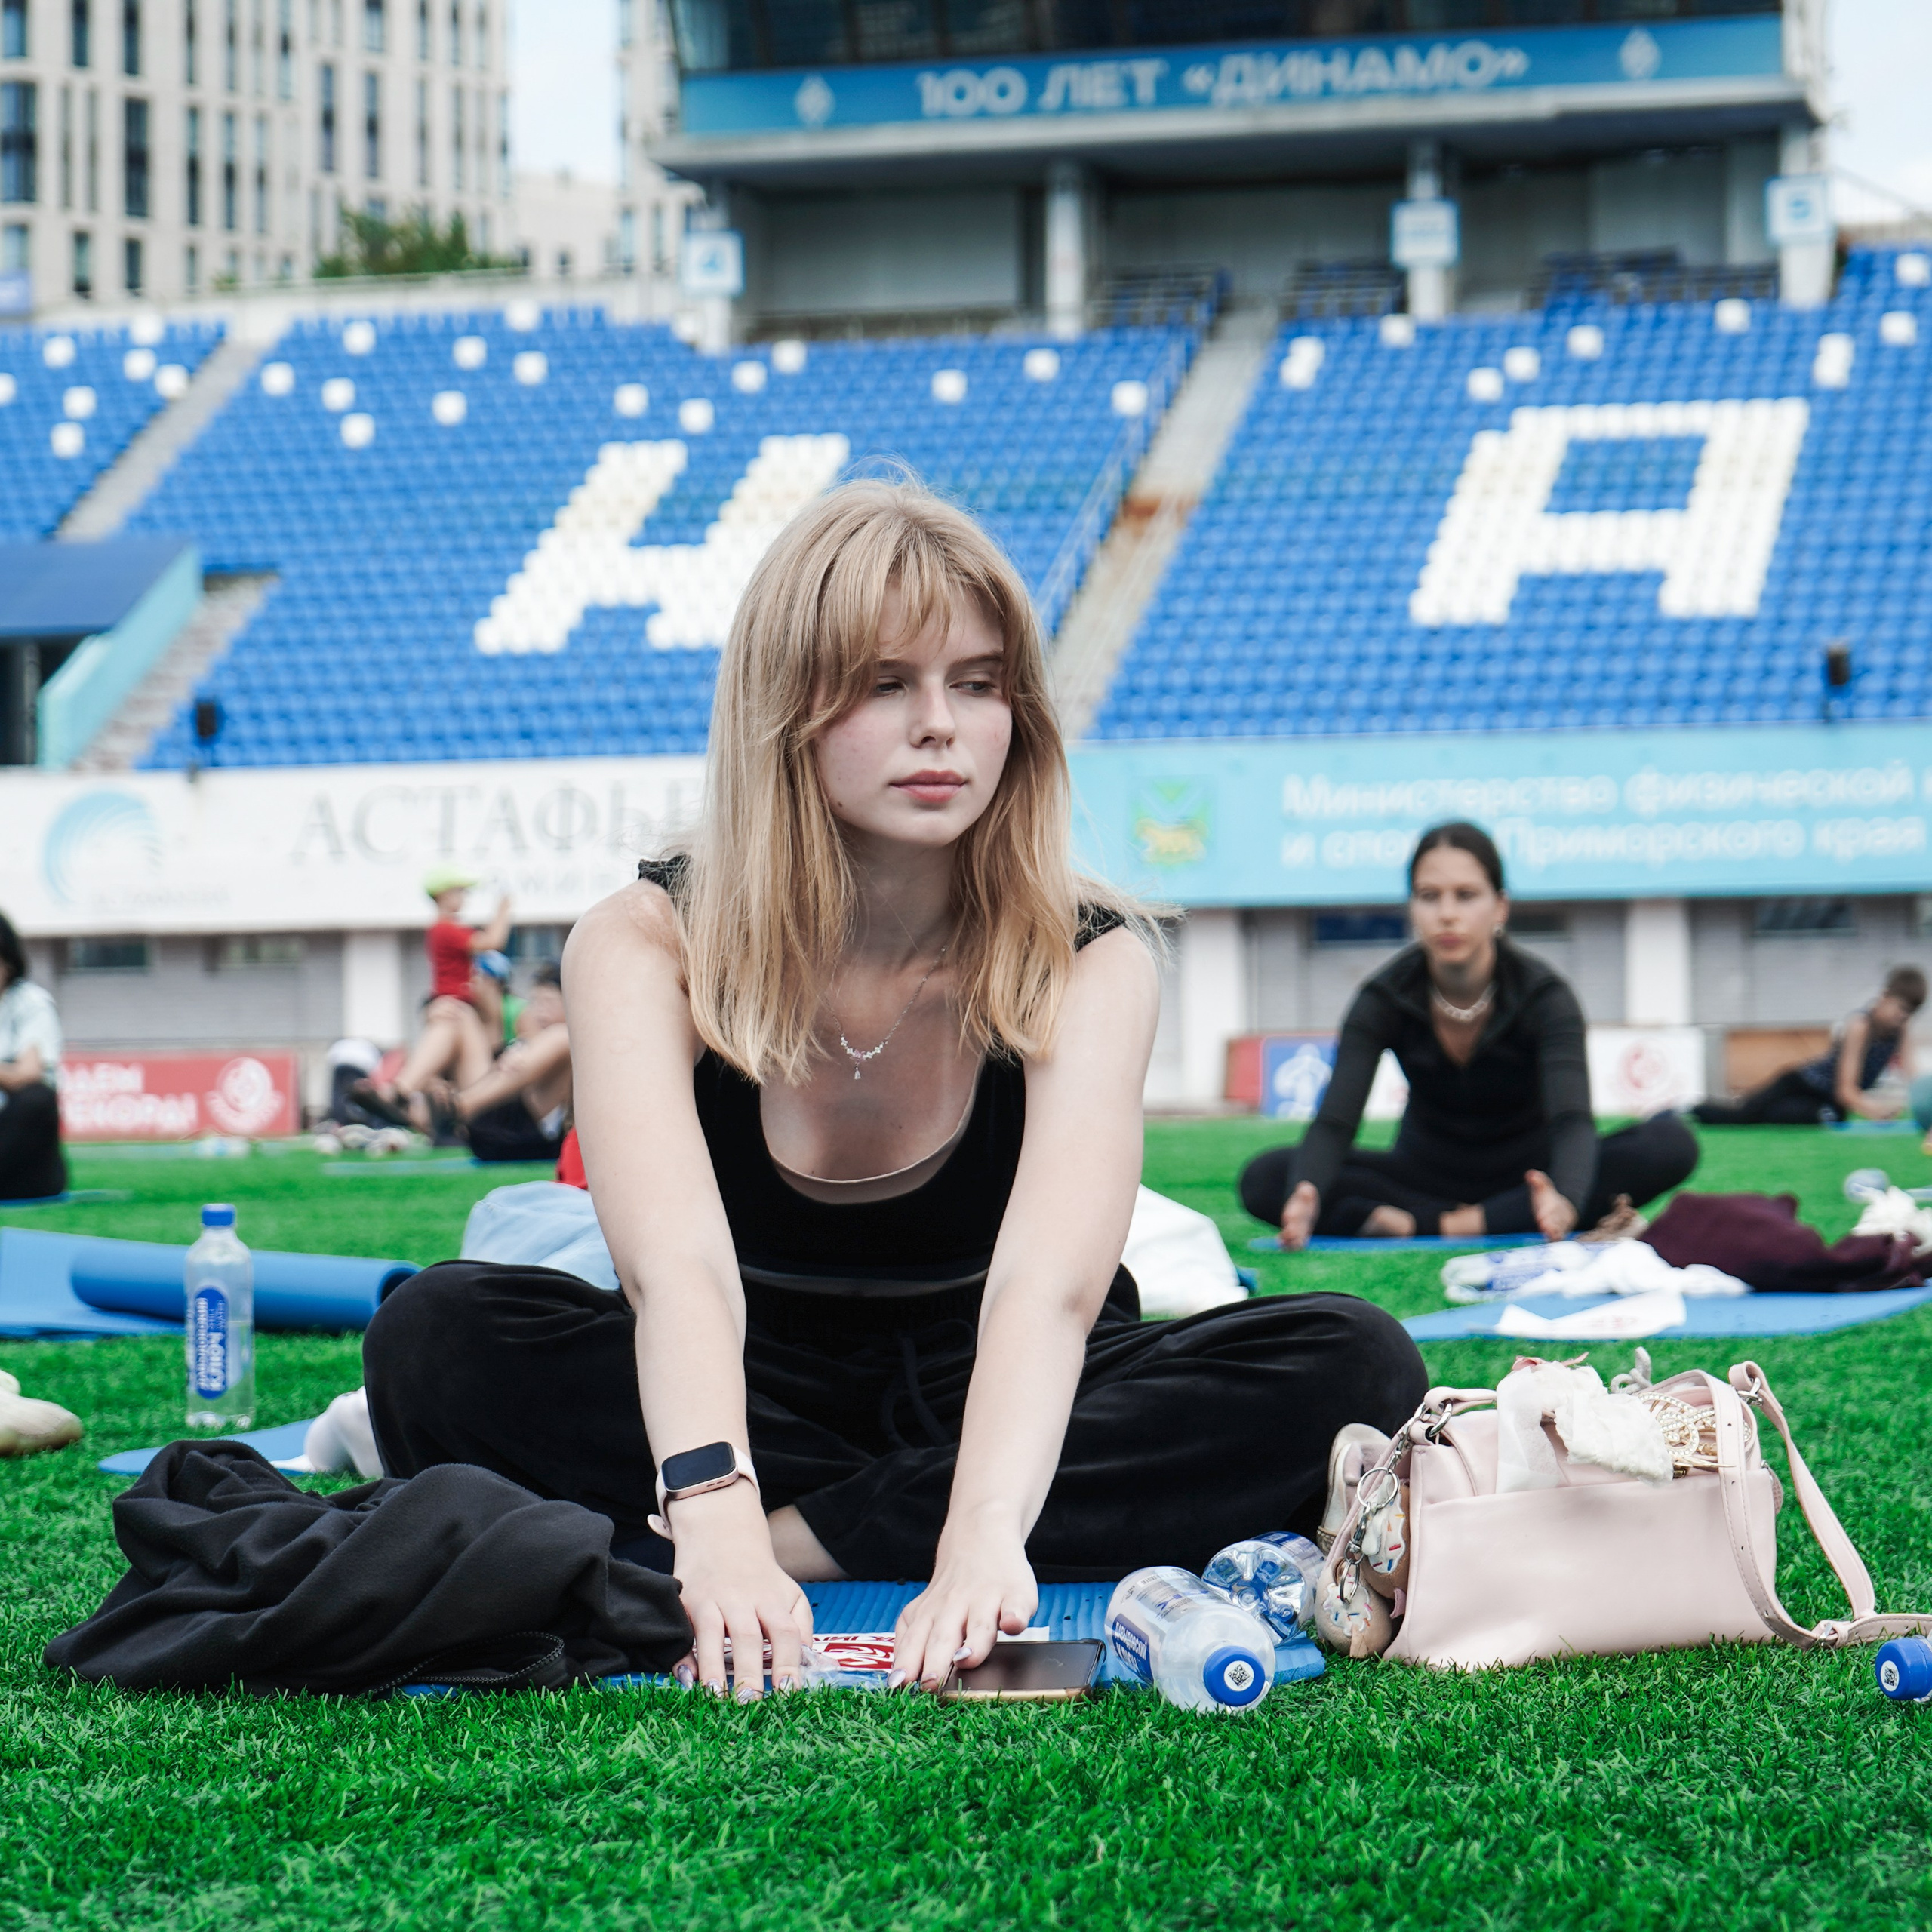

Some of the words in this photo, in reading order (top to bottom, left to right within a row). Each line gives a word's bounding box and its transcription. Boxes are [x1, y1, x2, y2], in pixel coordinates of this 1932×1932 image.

[915, 65, 1028, 118] 100
[1038, 58, 1168, 111] ЛЕТ
[1183, 40, 1530, 106] «ДИНАМО»
[1408, 396, 1810, 626] А
[1283, 774, 1618, 820] Министерство
[1624, 757, 1915, 819] физической
[1281, 832, 1315, 869] и
[1493, 817, 1805, 871] Приморского
[1814, 817, 1927, 866] края
